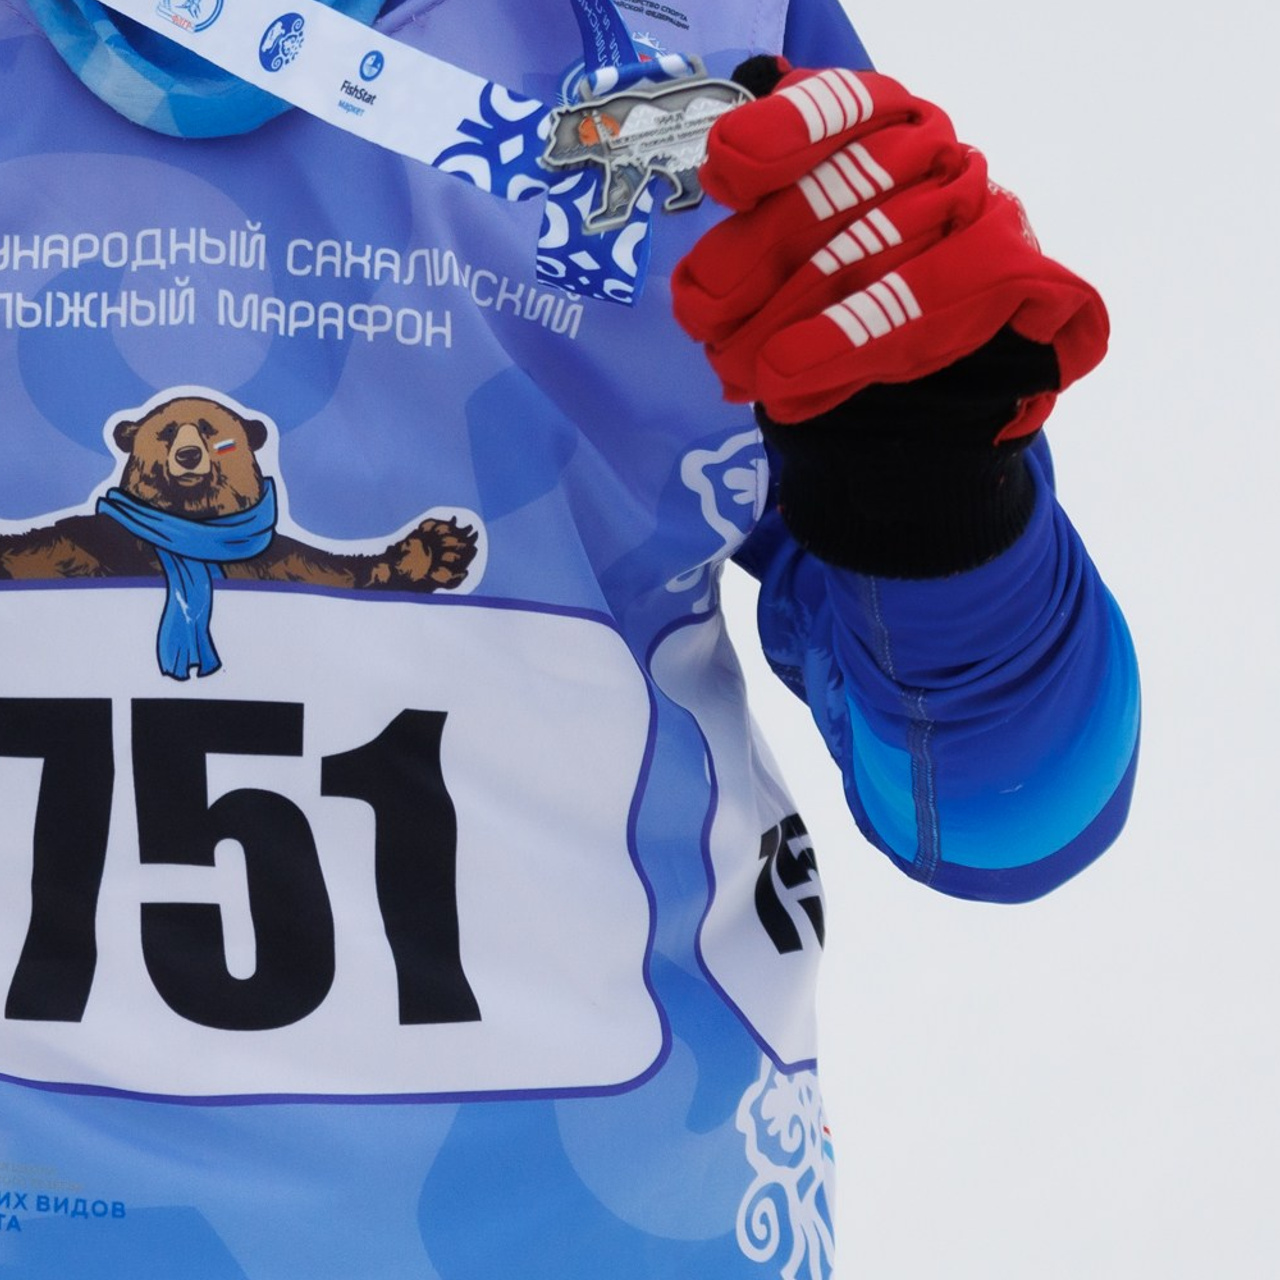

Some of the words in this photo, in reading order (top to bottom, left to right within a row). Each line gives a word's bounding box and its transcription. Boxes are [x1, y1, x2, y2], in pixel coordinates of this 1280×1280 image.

[340, 79, 377, 106] FishStat
[218, 289, 453, 349] МАРАФОН
[35, 1194, 126, 1219] ВИДОВ
